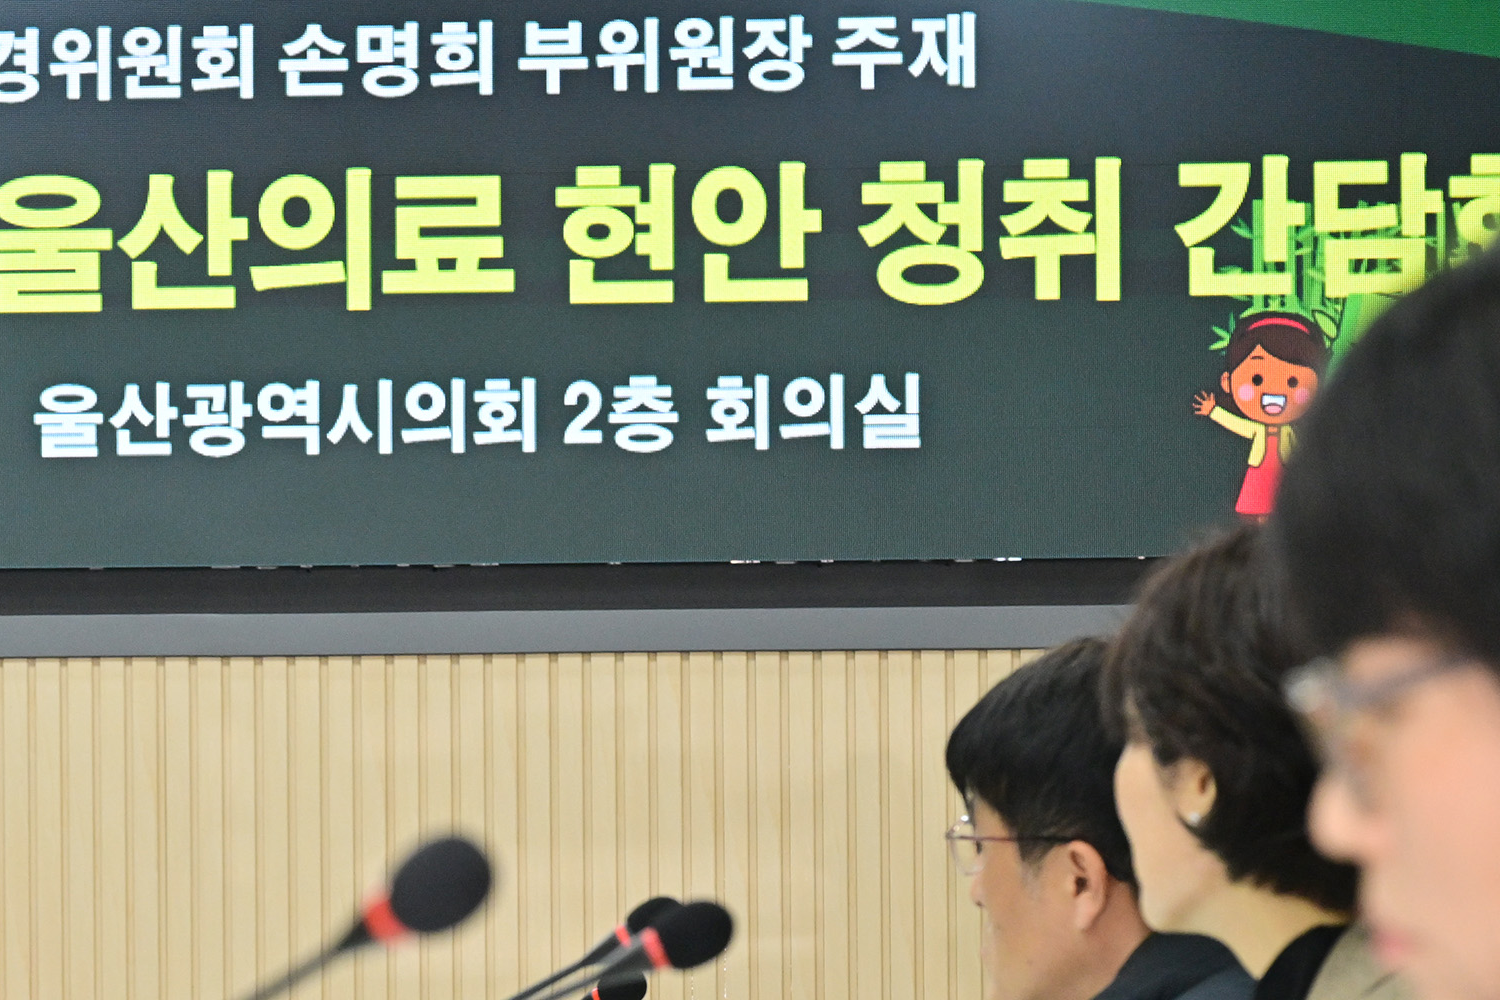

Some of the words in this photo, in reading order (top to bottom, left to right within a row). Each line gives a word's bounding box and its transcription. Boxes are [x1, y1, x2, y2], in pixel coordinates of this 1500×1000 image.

[277, 20, 494, 99] 손명희
[517, 16, 813, 95] 부위원장
[831, 11, 977, 90] 주재
[553, 162, 822, 306] 현안
[858, 155, 1123, 306] 청취
[32, 377, 537, 459] 울산광역시의회
[562, 376, 680, 454] 2층
[704, 372, 922, 452] 회의실
